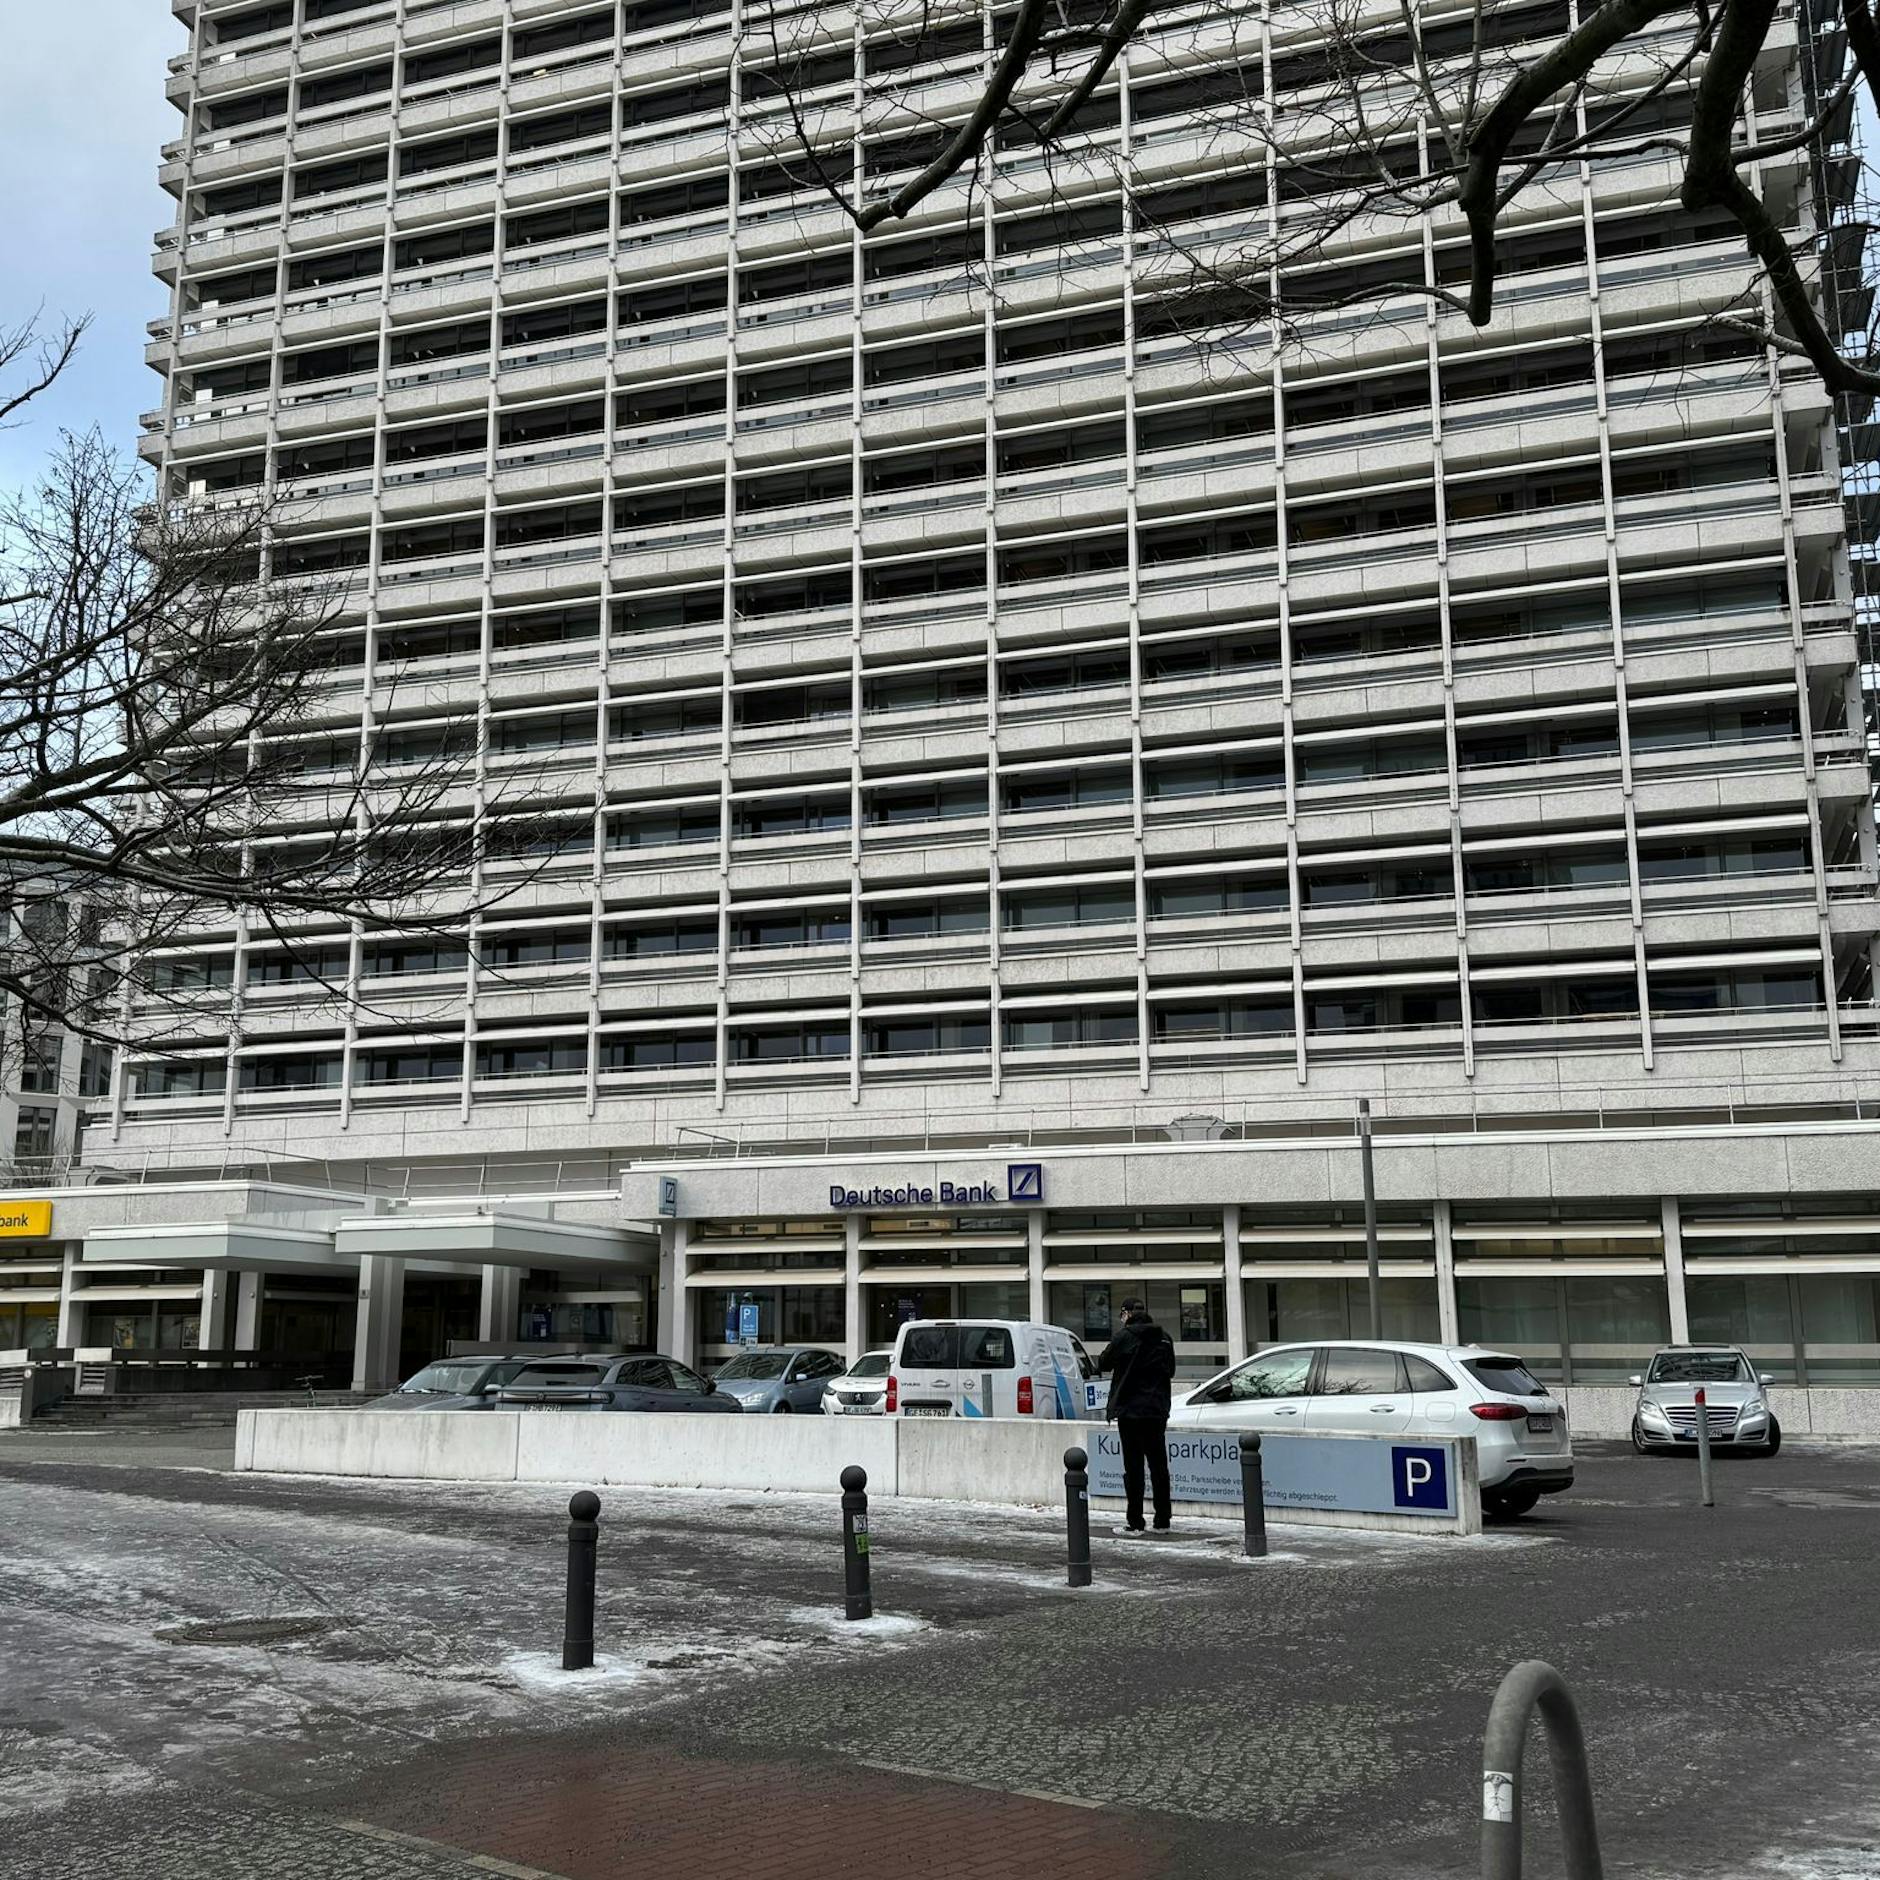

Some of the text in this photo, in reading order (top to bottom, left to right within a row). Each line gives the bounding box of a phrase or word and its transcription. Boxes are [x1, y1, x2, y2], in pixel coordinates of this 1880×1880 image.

[830, 1181, 998, 1206] Deutsche Bank
[743, 1308, 751, 1320] P
[1098, 1435, 1238, 1464] Kuparkpla
[1405, 1456, 1432, 1498] P
